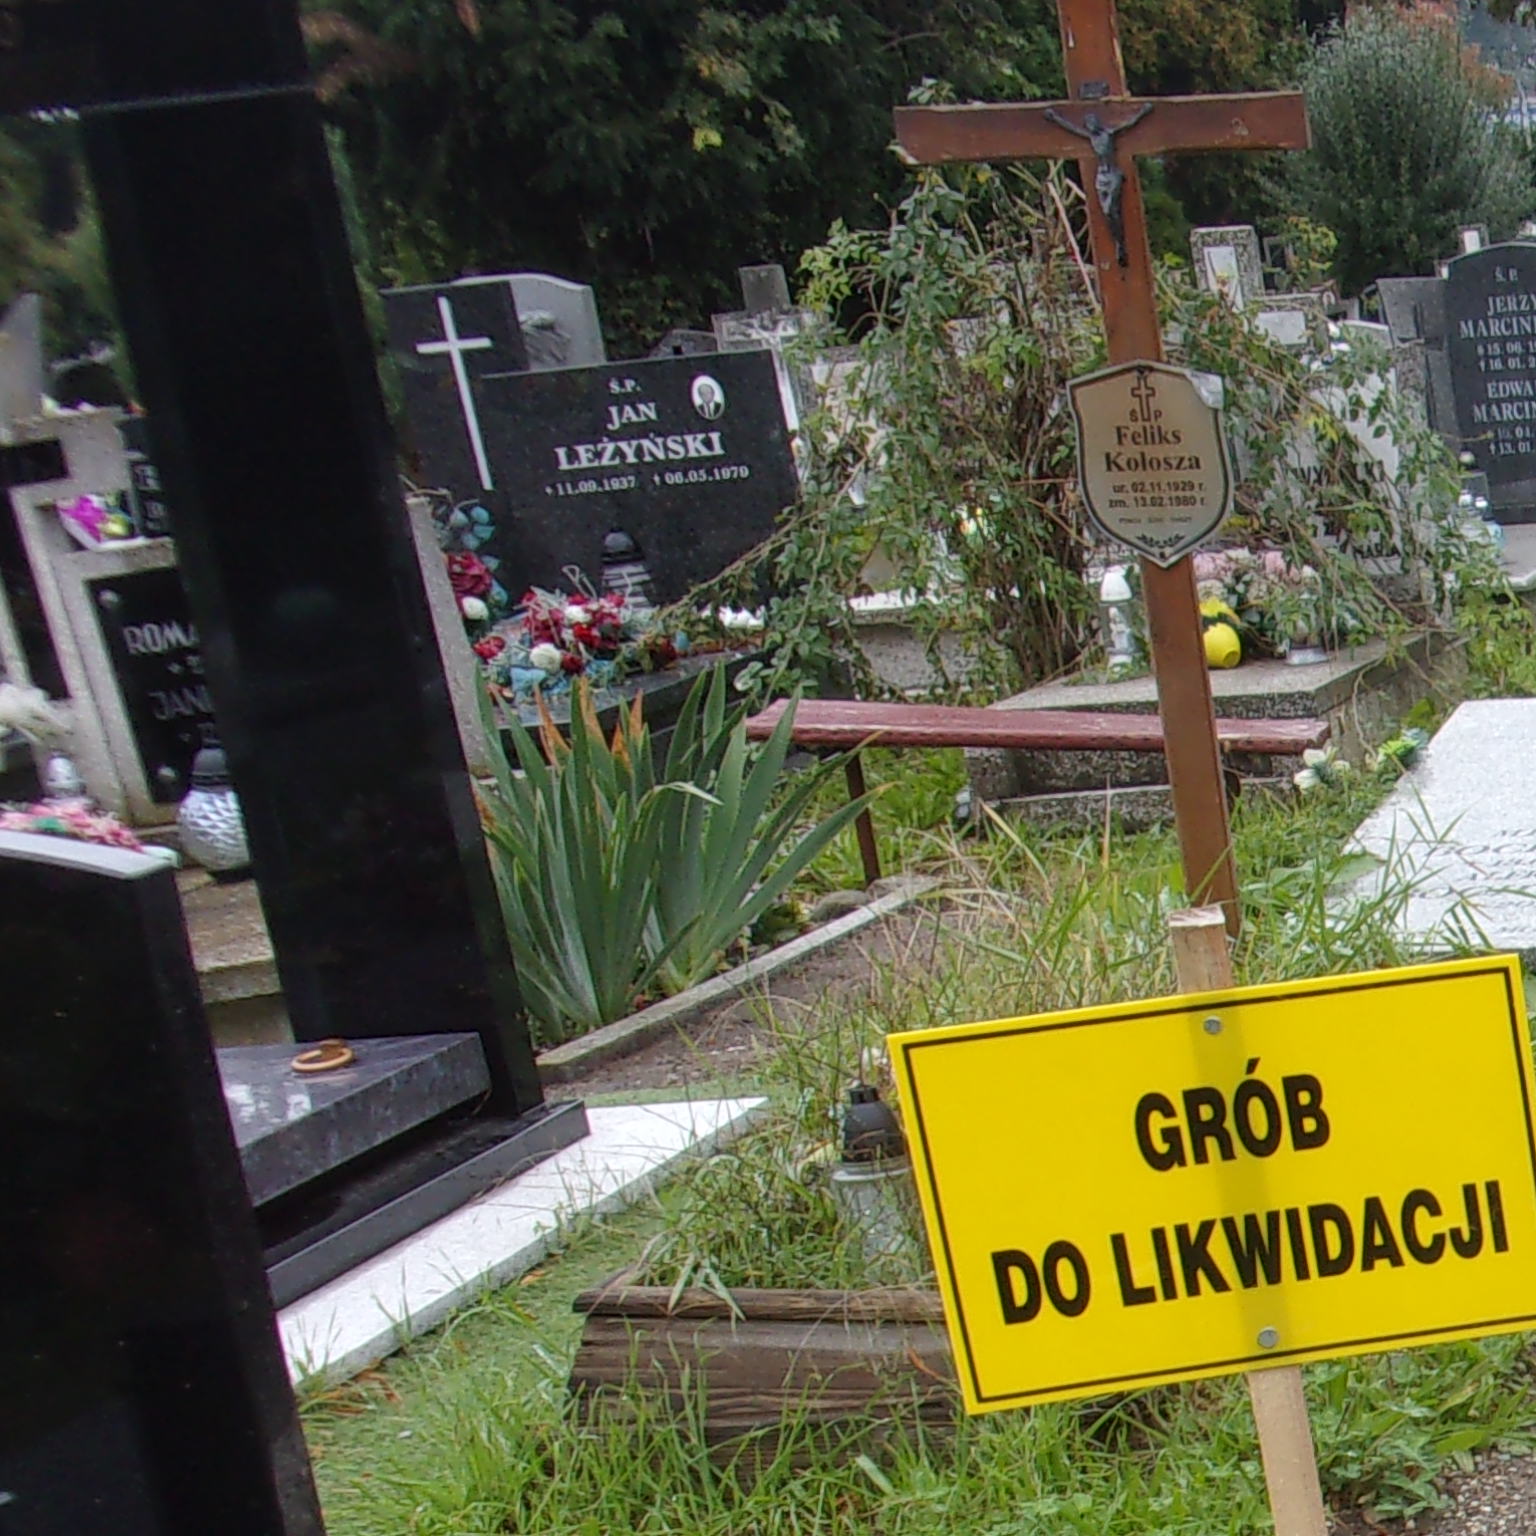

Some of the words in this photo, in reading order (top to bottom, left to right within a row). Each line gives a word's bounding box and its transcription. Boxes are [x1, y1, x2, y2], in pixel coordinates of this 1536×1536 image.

[606, 403, 658, 430] JAN
[554, 432, 725, 470] LEŻYŃSKI
[1115, 425, 1182, 446] Feliks
[1112, 484, 1129, 494] ur.
[1134, 1057, 1330, 1173] GRÓB
[992, 1240, 1091, 1325] DO
[1110, 1180, 1510, 1308] LIKWIDACJI
